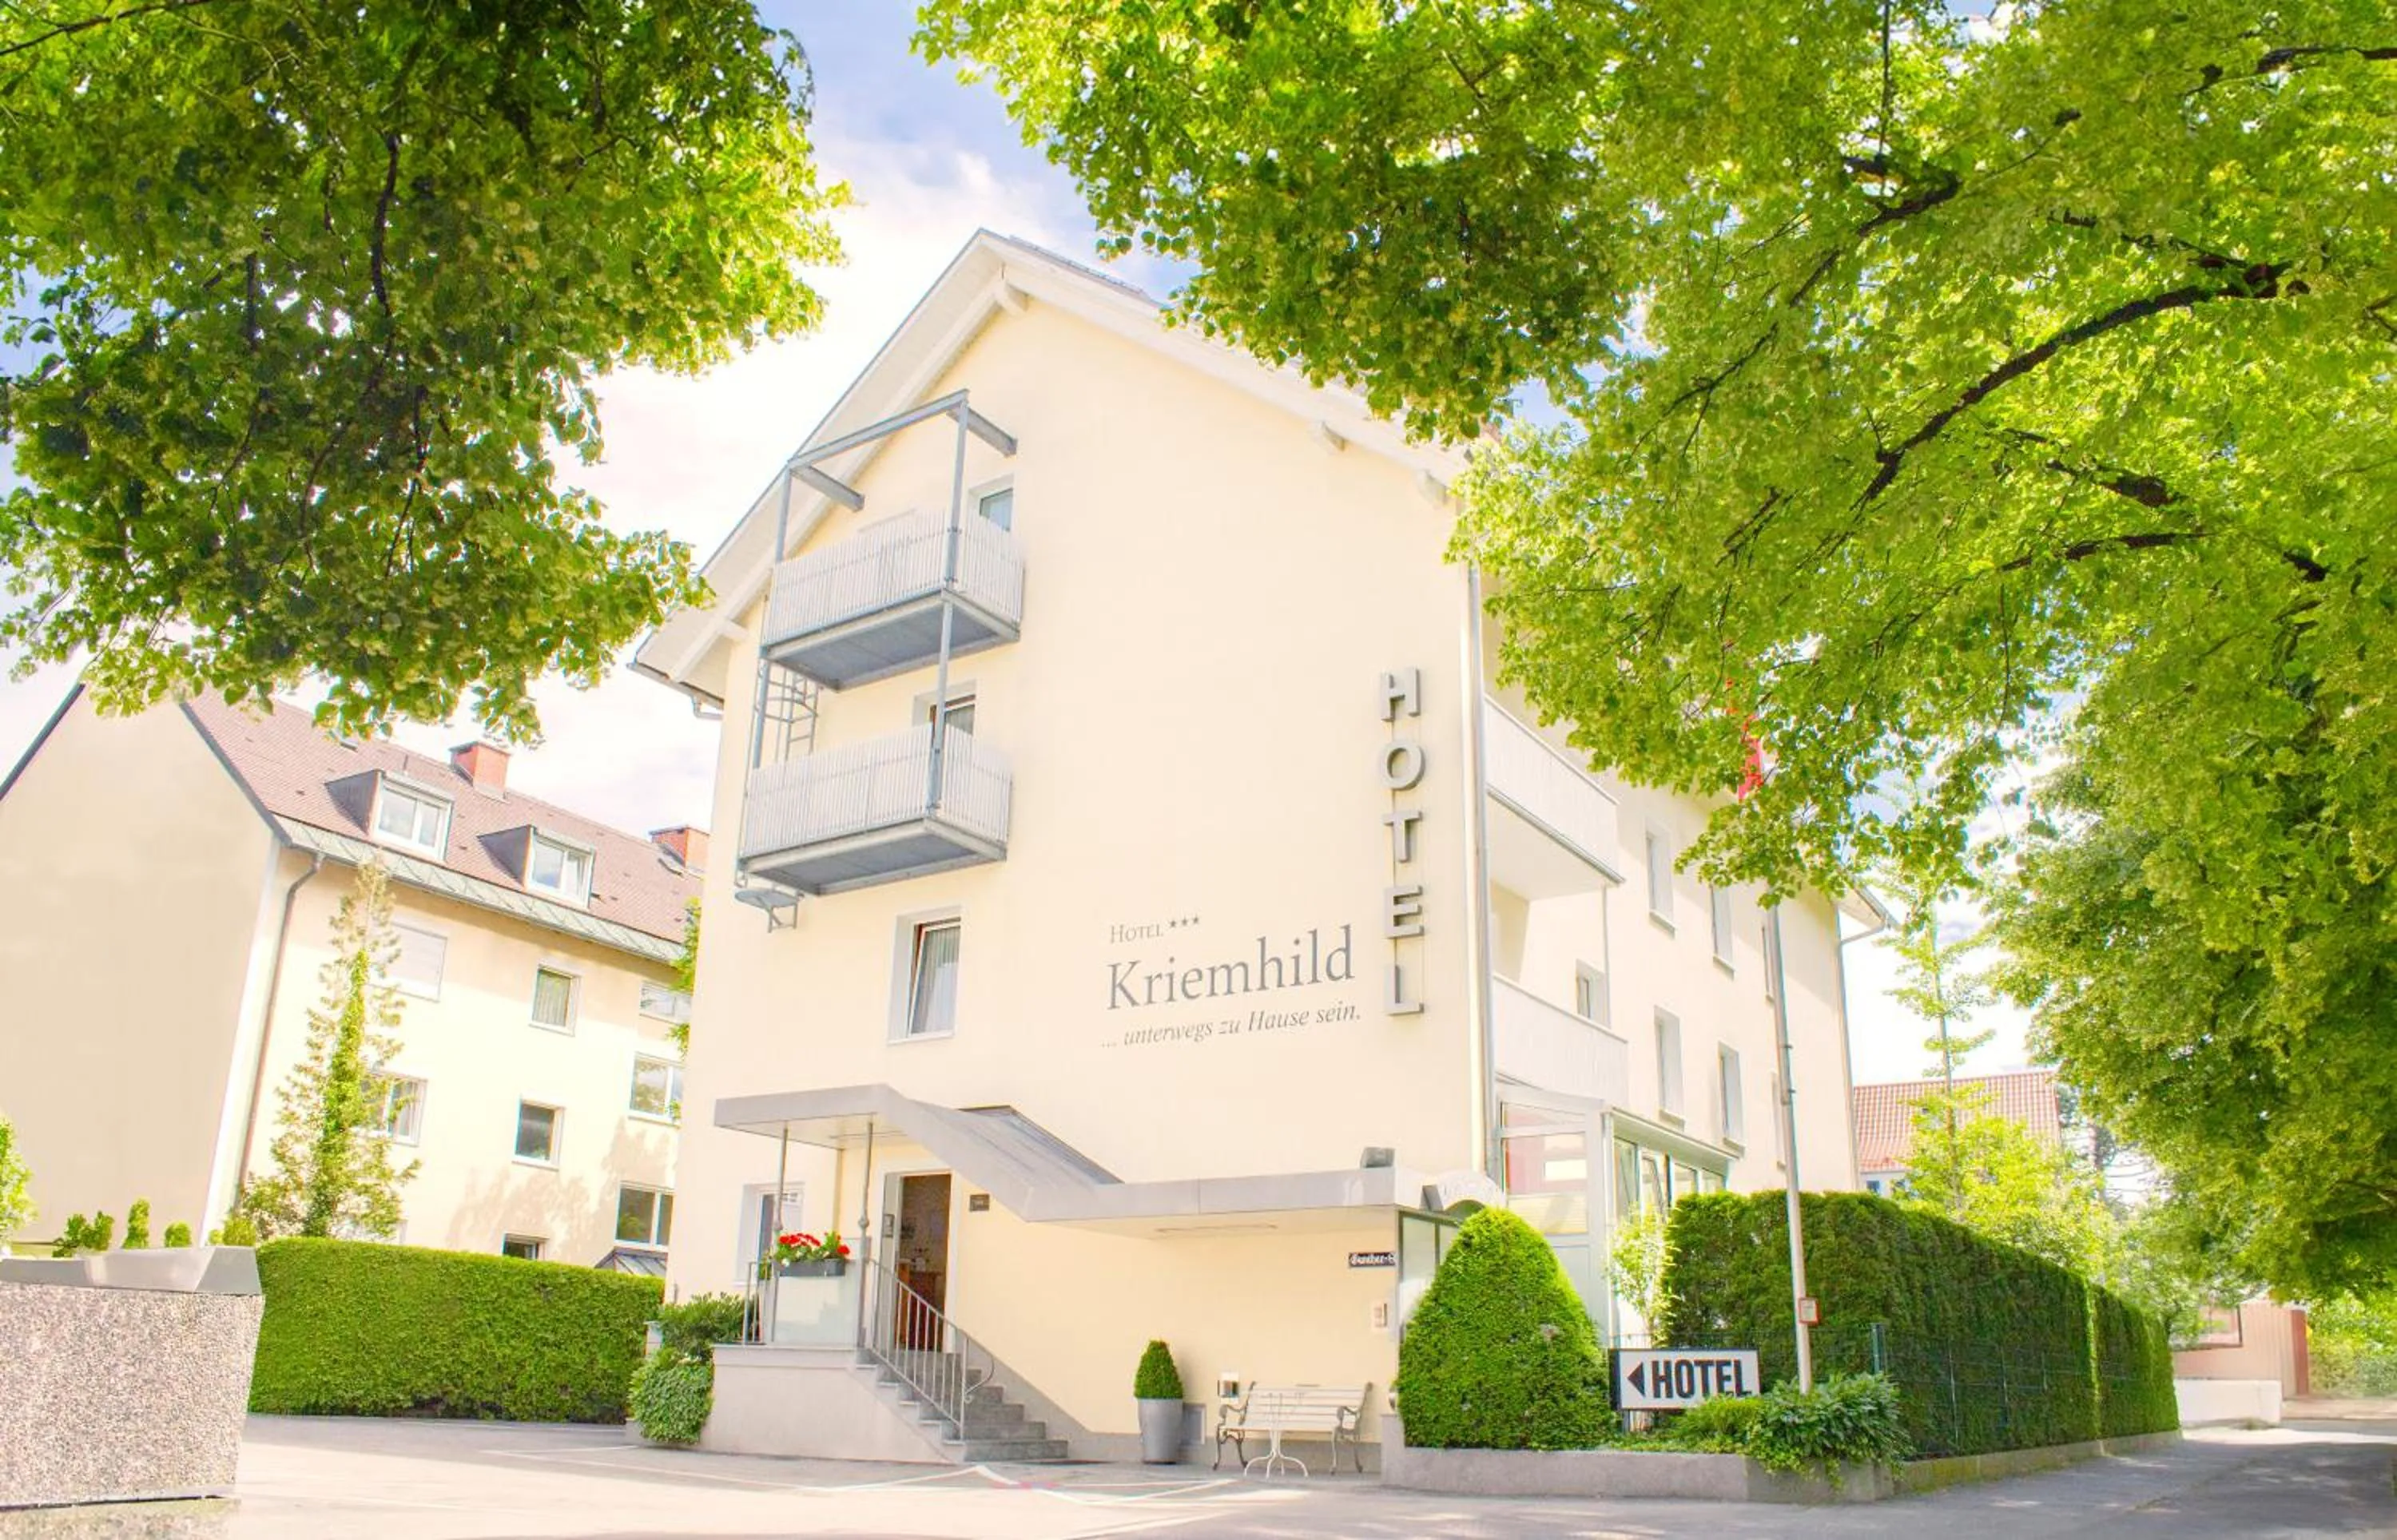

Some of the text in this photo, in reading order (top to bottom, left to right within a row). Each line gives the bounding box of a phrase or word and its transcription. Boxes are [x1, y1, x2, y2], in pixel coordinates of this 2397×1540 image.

[1380, 666, 1425, 1016] HOTEL
[1110, 923, 1164, 944] HOTEL
[1107, 924, 1356, 1010] Kriemhild
[1124, 1022, 1214, 1047] unterwegs
[1218, 1020, 1240, 1036] zu
[1247, 1009, 1310, 1032] Hause
[1316, 1000, 1361, 1024] sein.
[1652, 1359, 1752, 1399] HOTEL
